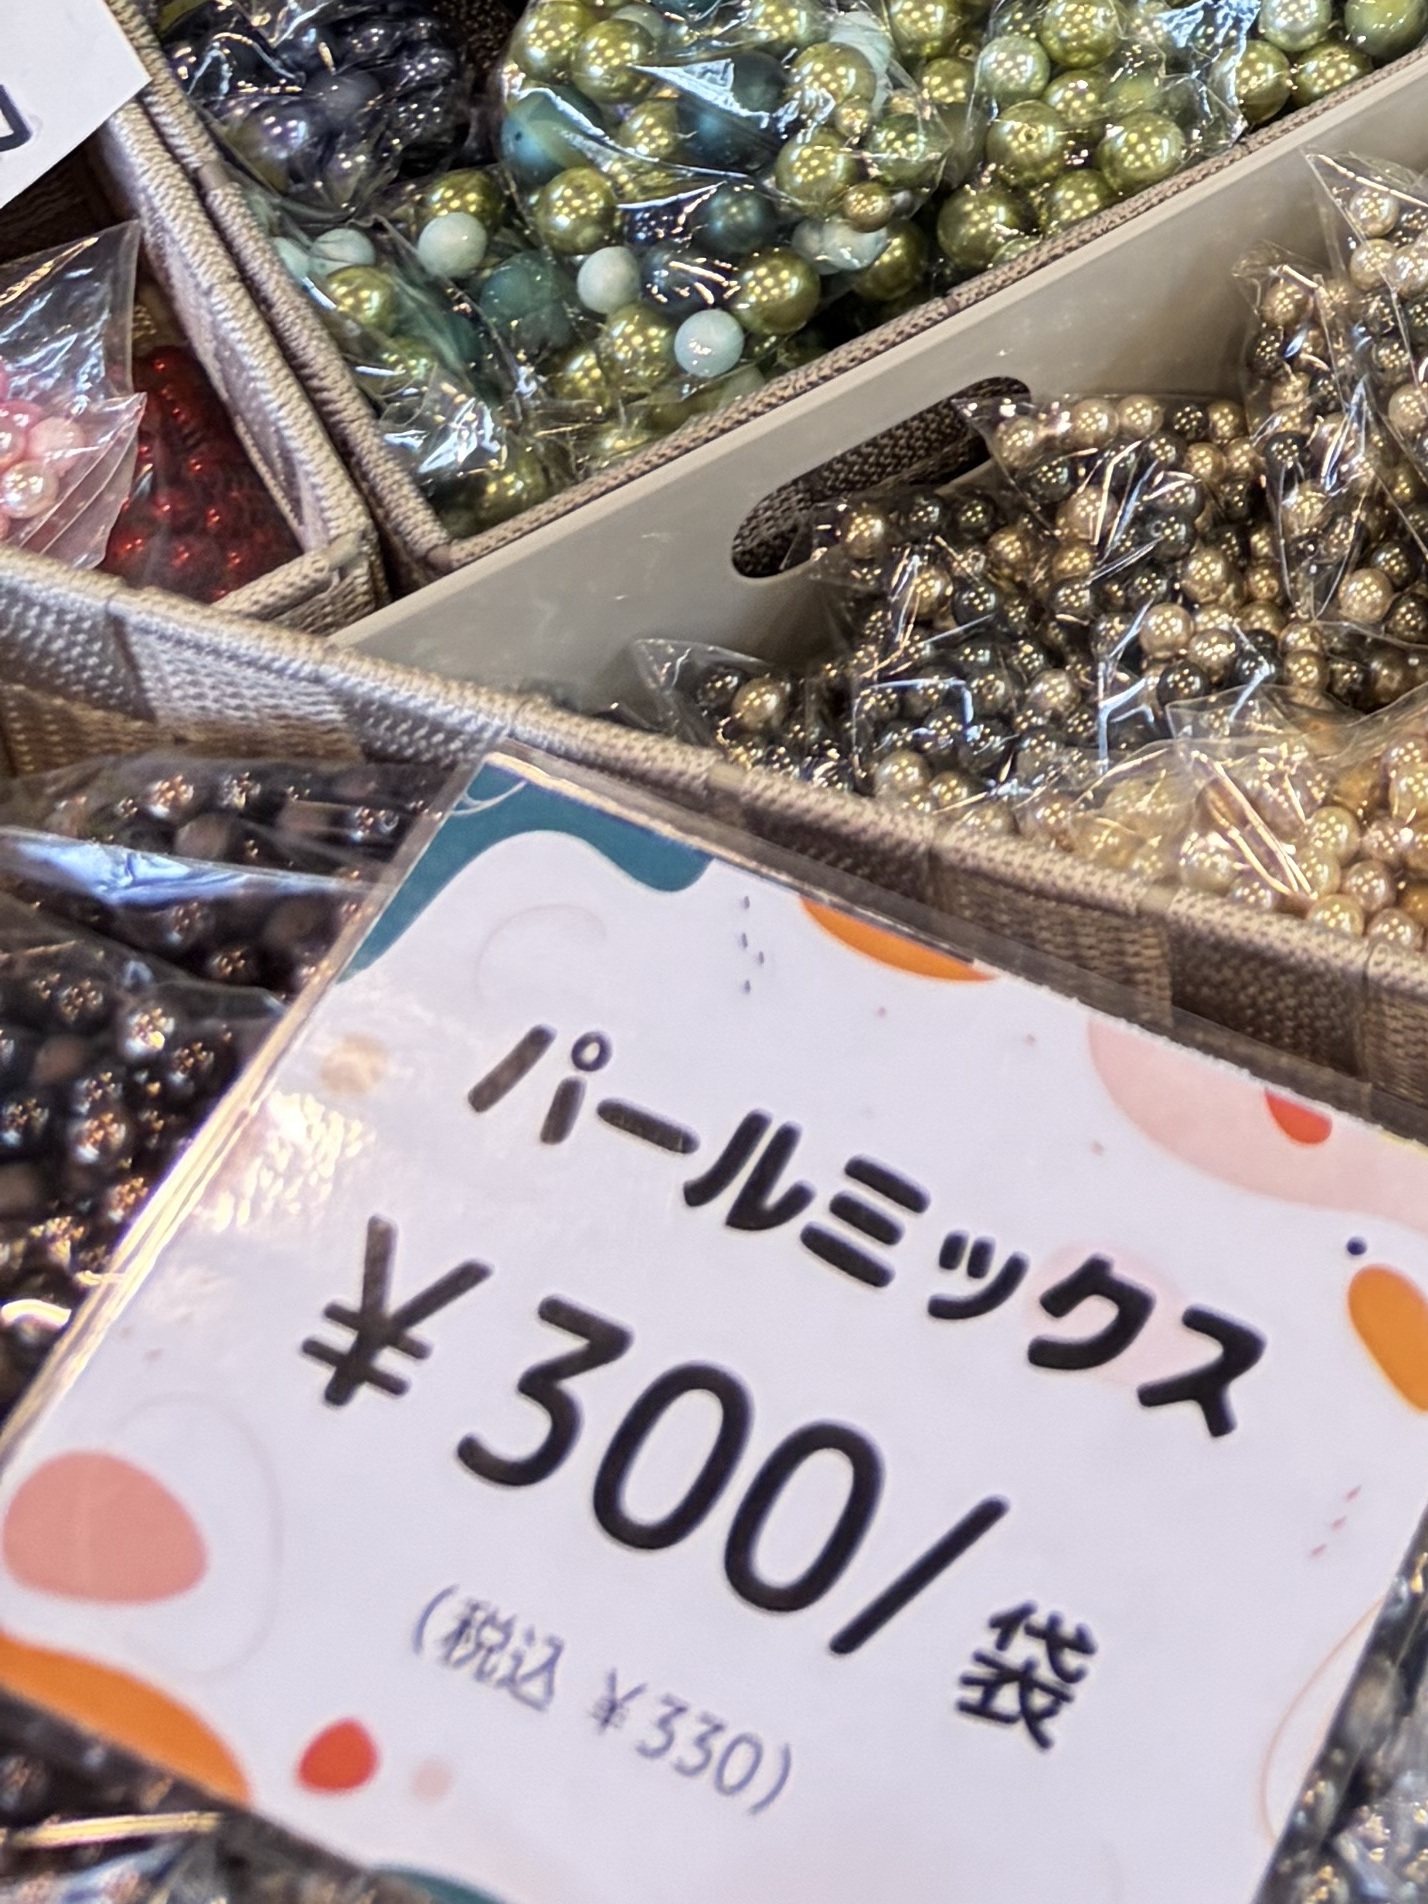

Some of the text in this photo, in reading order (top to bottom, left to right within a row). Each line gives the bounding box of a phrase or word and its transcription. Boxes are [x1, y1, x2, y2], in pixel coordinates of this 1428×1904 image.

[468, 1023, 1268, 1442] パールミックス
